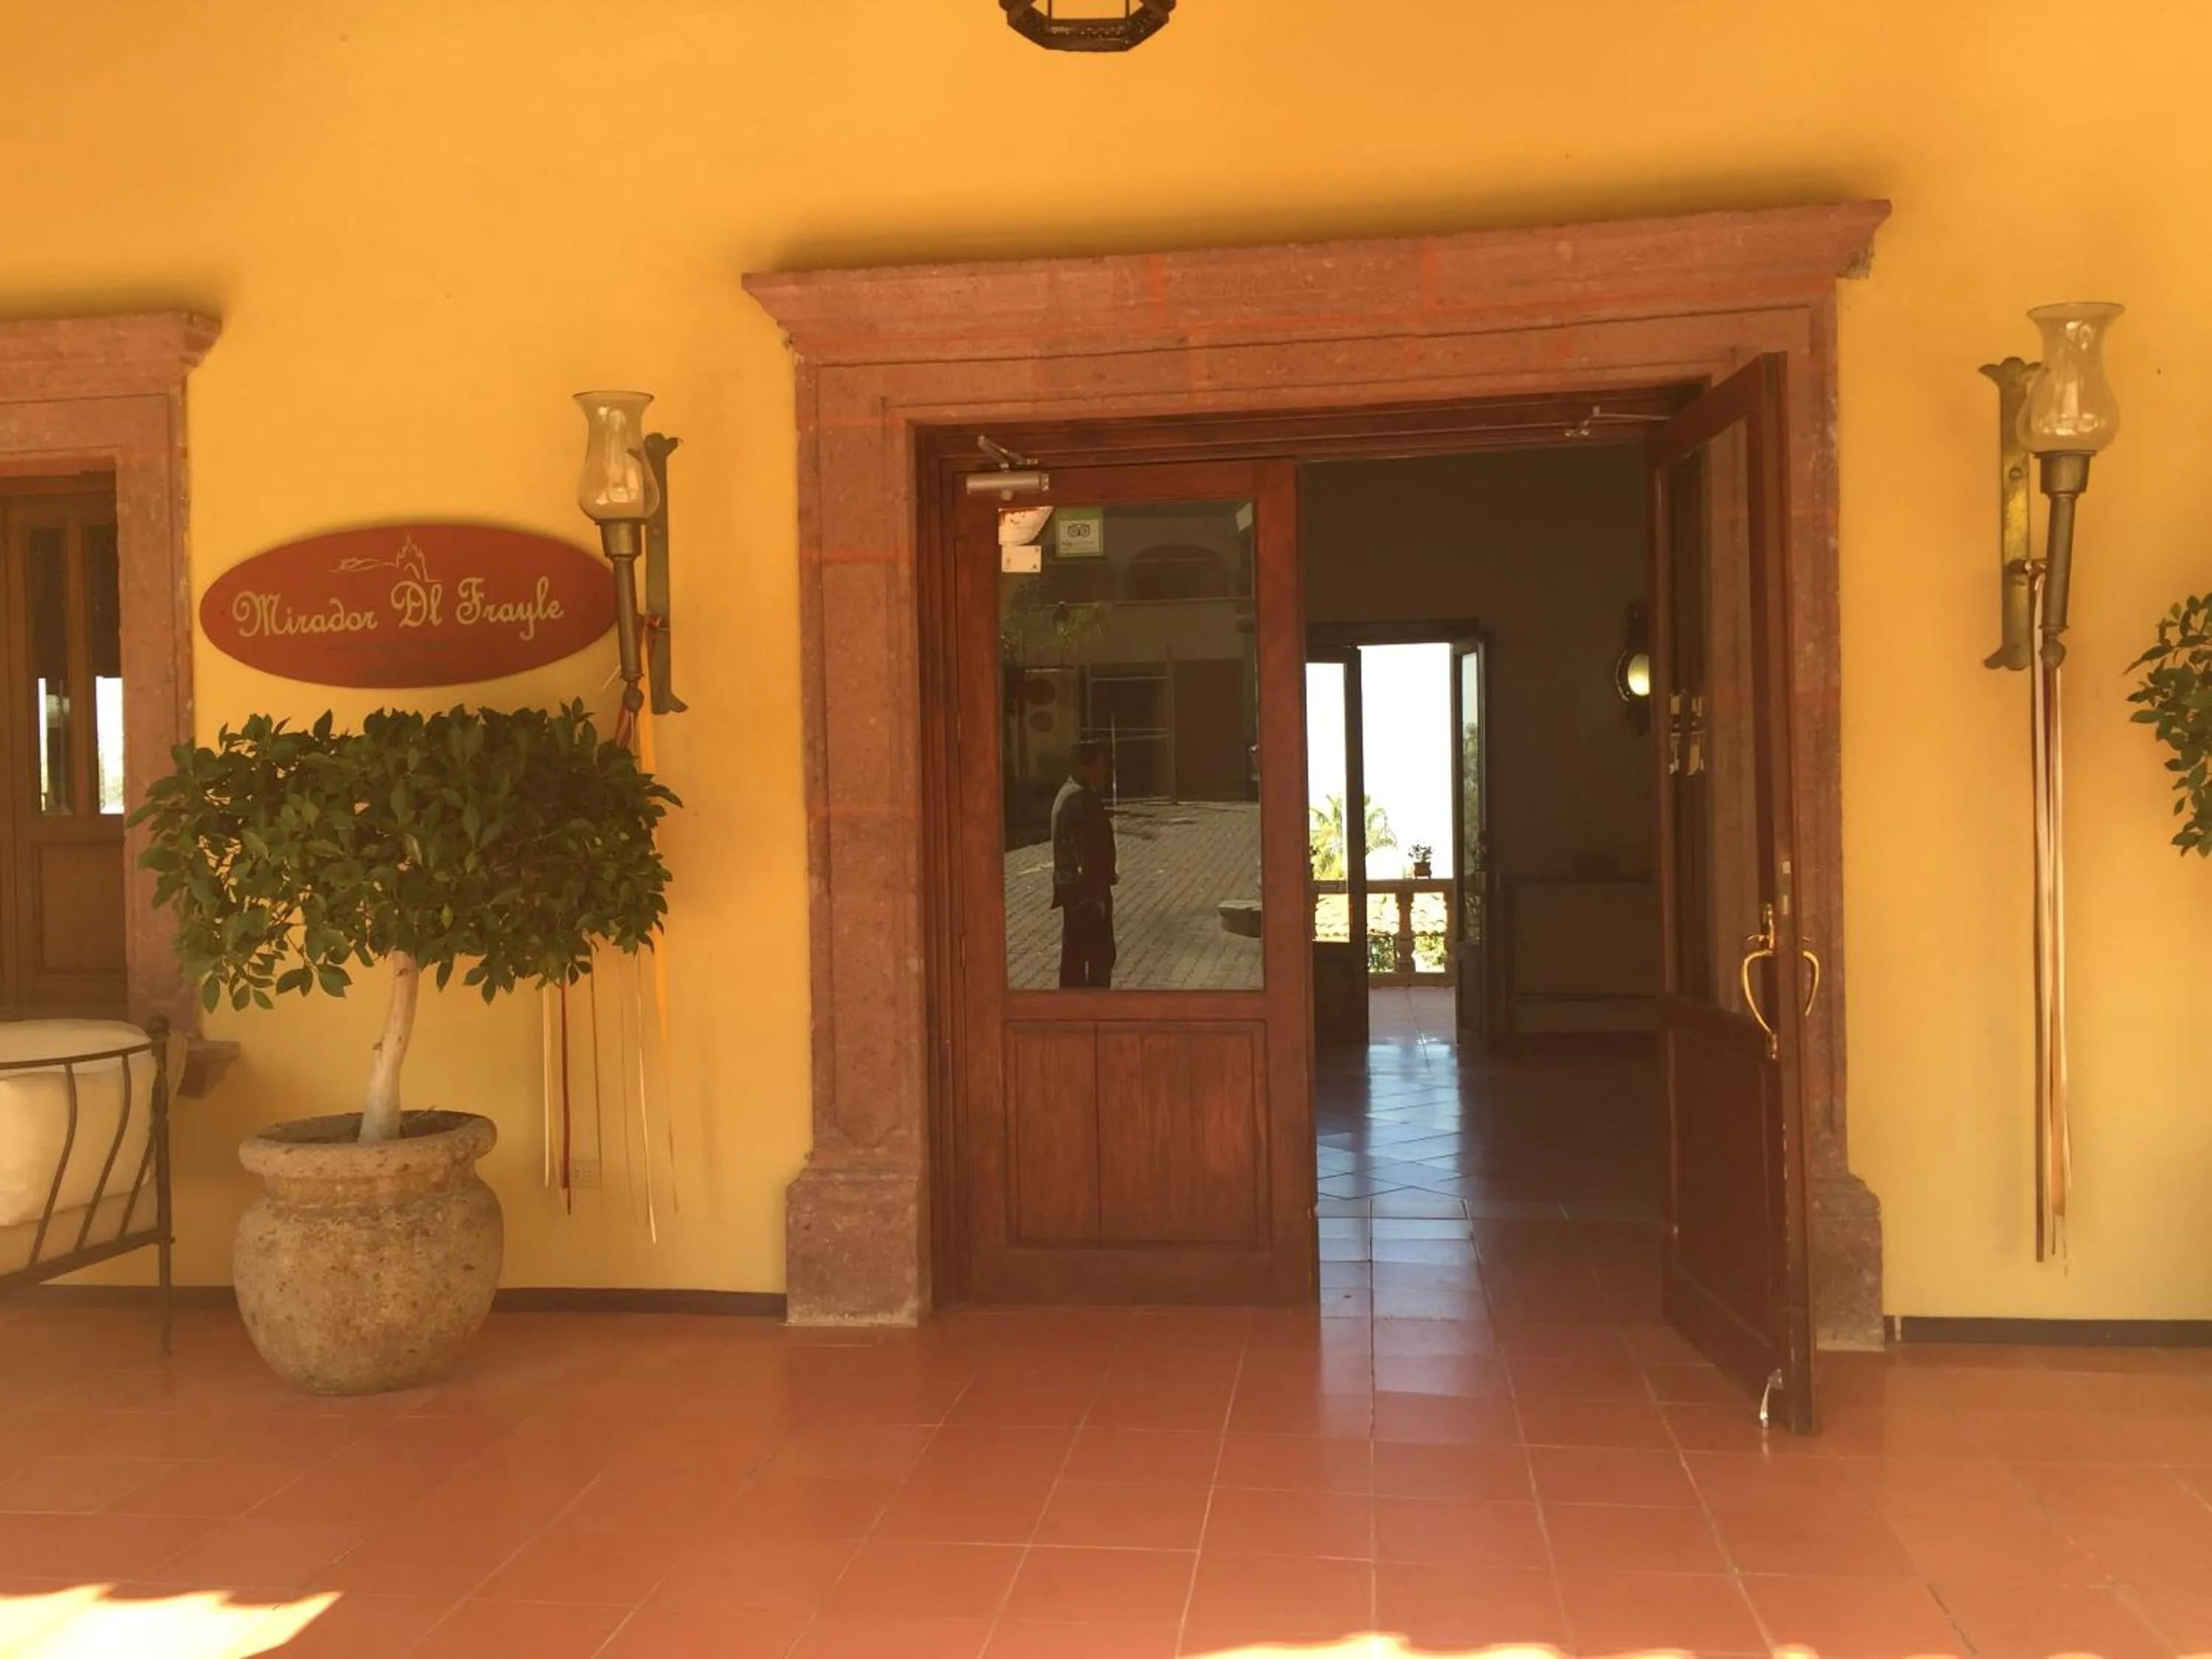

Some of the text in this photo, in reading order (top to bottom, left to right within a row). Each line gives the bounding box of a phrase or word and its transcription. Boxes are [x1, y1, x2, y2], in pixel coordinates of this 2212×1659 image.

[232, 575, 564, 641] Mirador Dl Frayle
